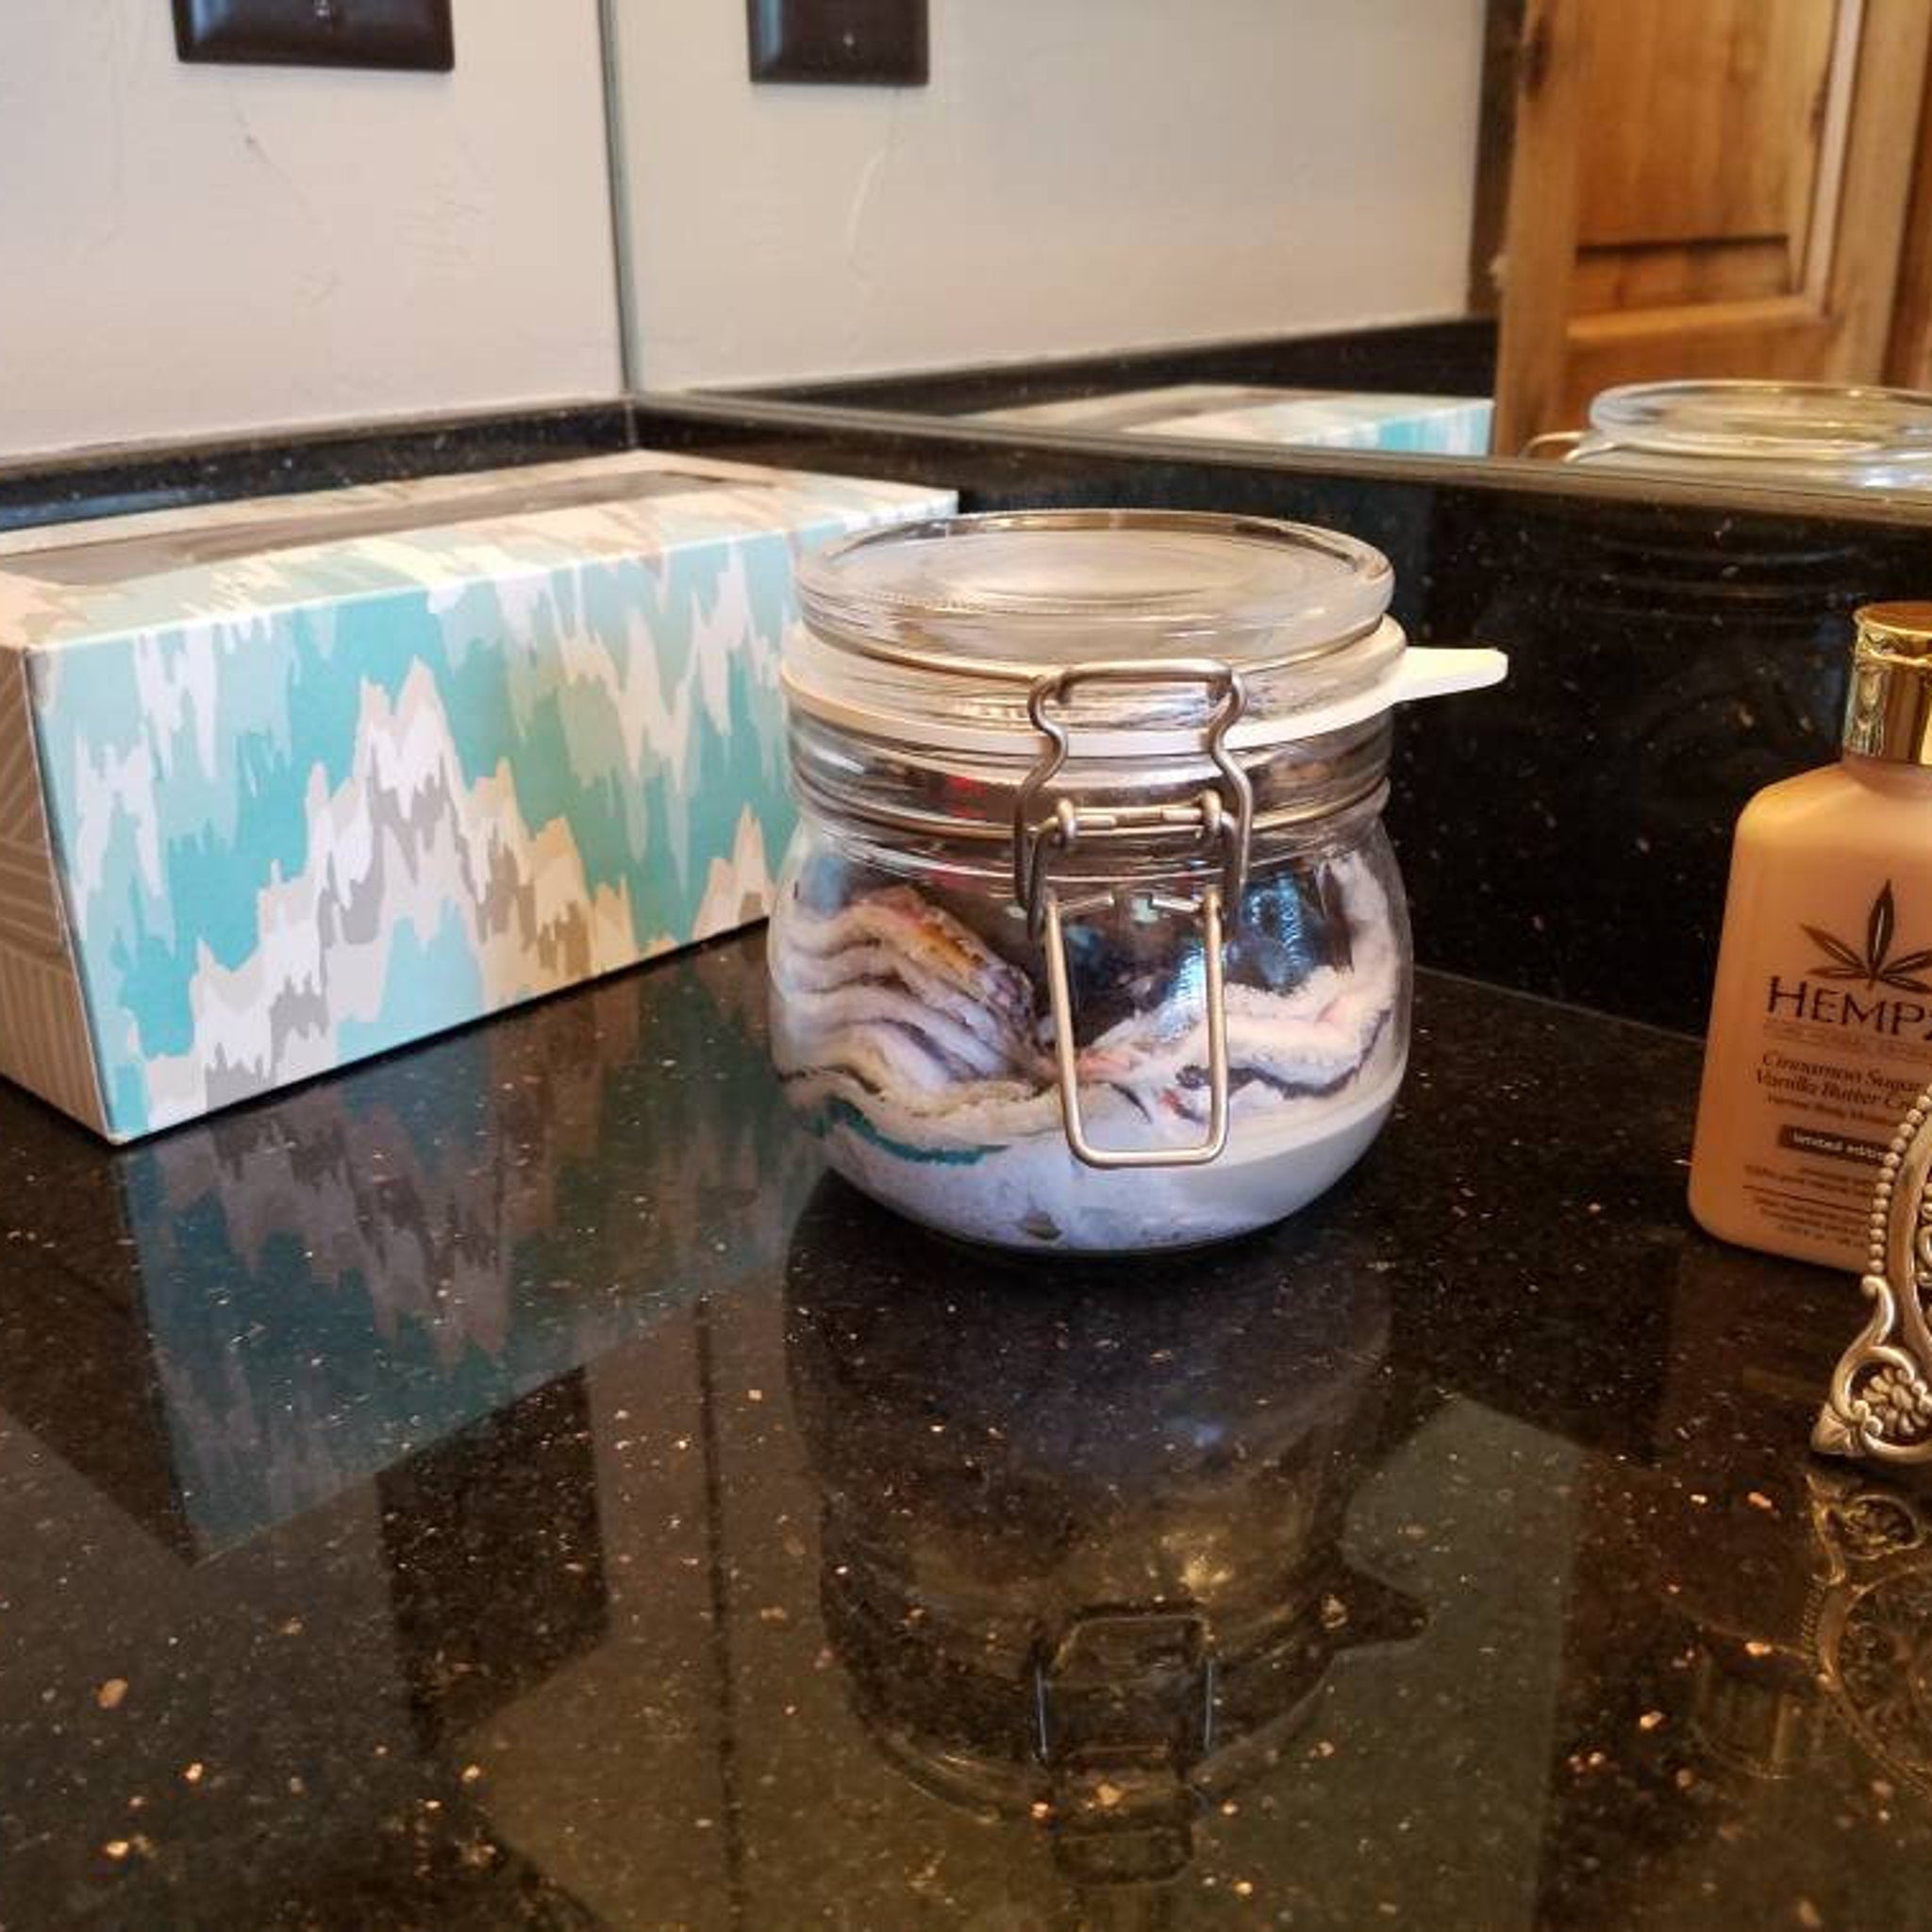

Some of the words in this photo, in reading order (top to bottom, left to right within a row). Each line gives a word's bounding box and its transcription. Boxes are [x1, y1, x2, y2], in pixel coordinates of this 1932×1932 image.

[1768, 975, 1932, 1041] HEMP
[1757, 1068, 1818, 1095] Vanilla
[1821, 1081, 1880, 1106] Butter
[1762, 1050, 1862, 1084] Cinnamon
[1865, 1068, 1924, 1094] Sugar
